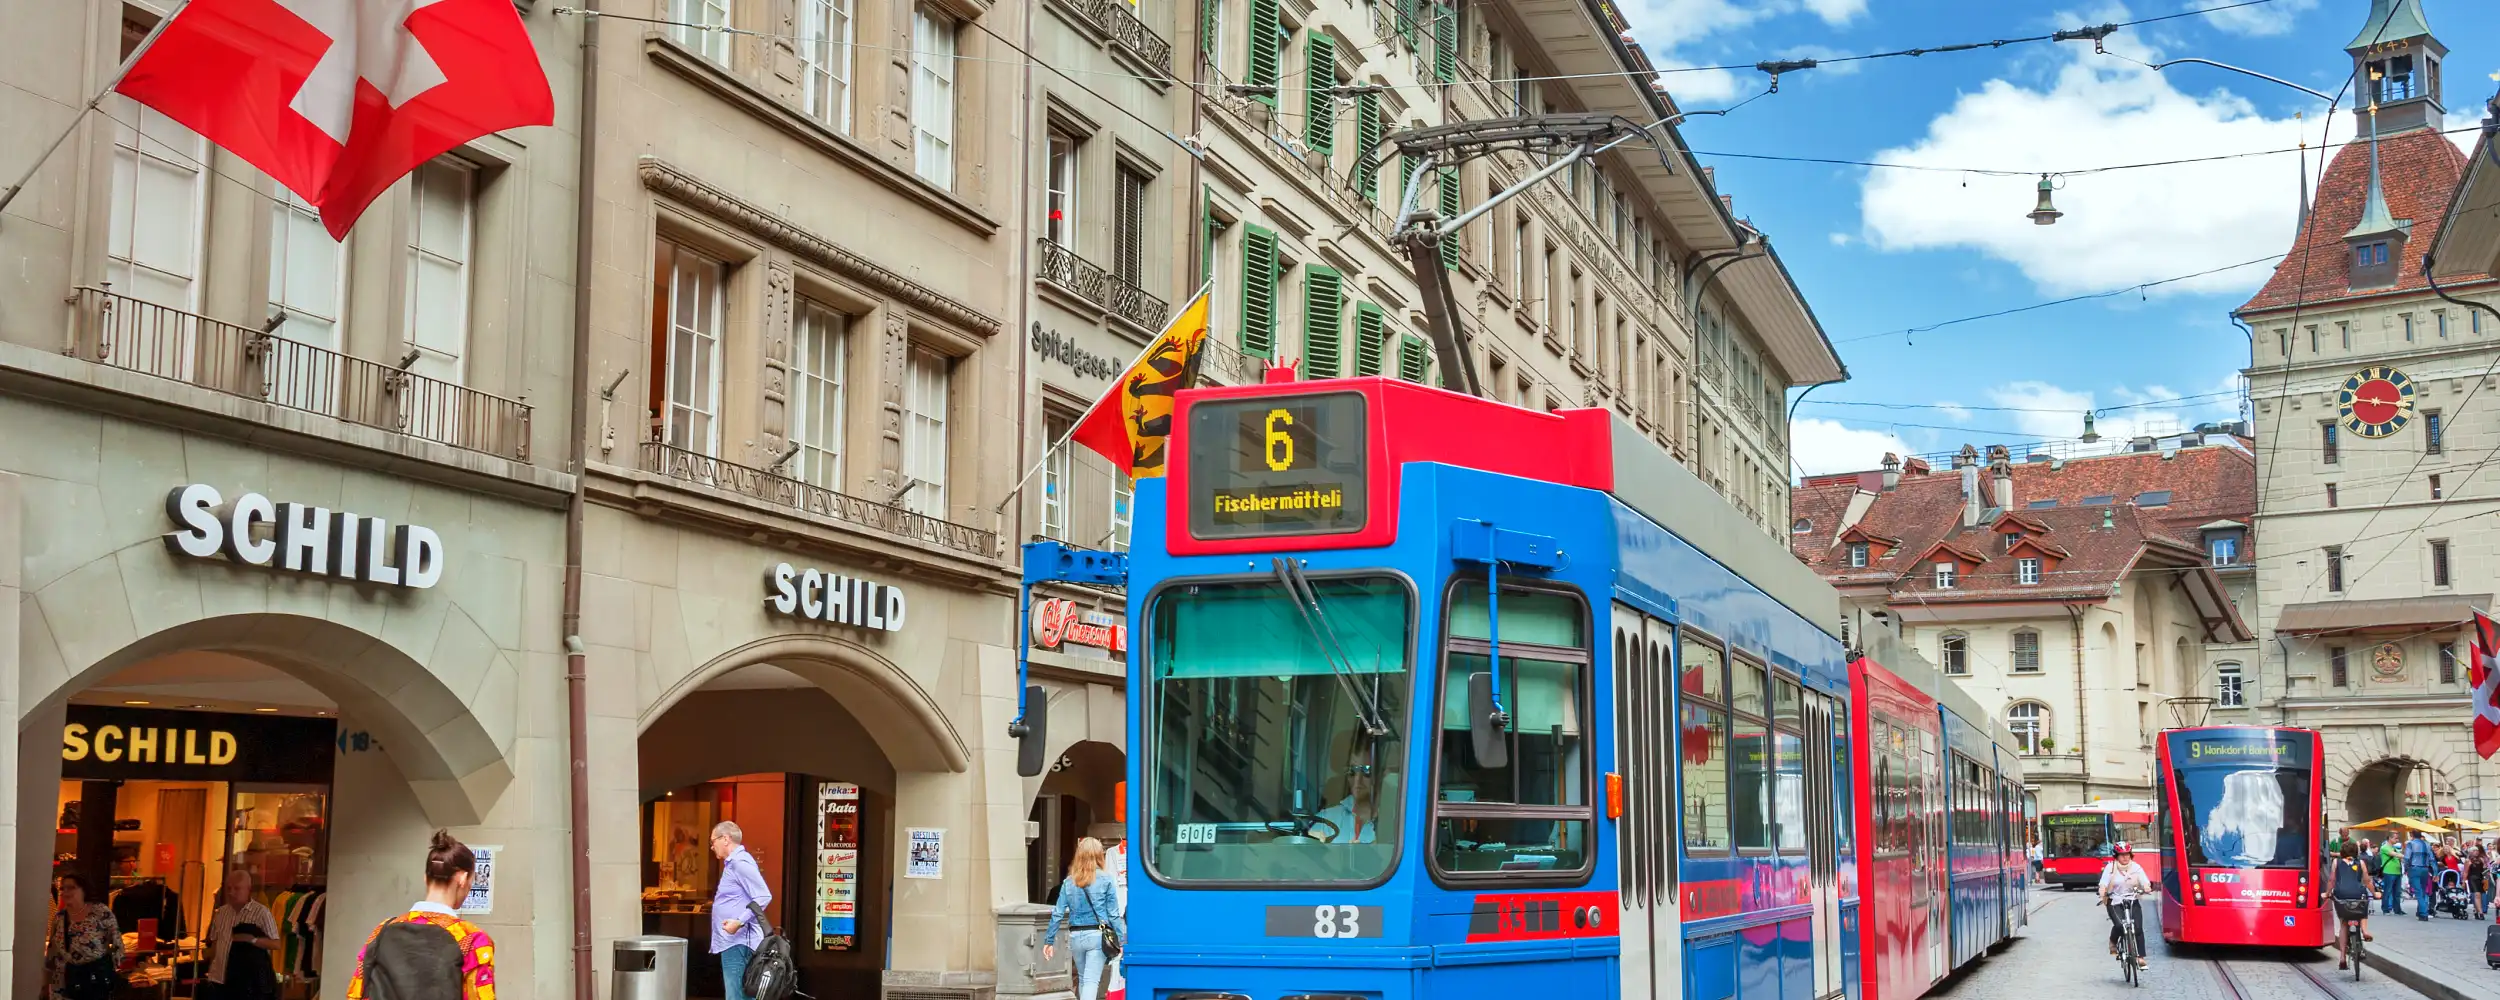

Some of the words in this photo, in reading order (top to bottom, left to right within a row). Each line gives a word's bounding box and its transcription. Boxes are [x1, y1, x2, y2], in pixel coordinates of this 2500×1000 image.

[1031, 320, 1124, 382] Spitalgass-P
[1265, 408, 1294, 472] 6
[1214, 489, 1342, 513] Fischermätteli
[165, 484, 444, 589] SCHILD
[766, 562, 906, 632] SCHILD
[62, 723, 237, 766] SCHILD
[2191, 741, 2201, 759] 9
[826, 802, 858, 814] Bata
[2210, 873, 2234, 883] 667
[2255, 889, 2291, 897] NEUTRAL
[1314, 904, 1360, 939] 83
